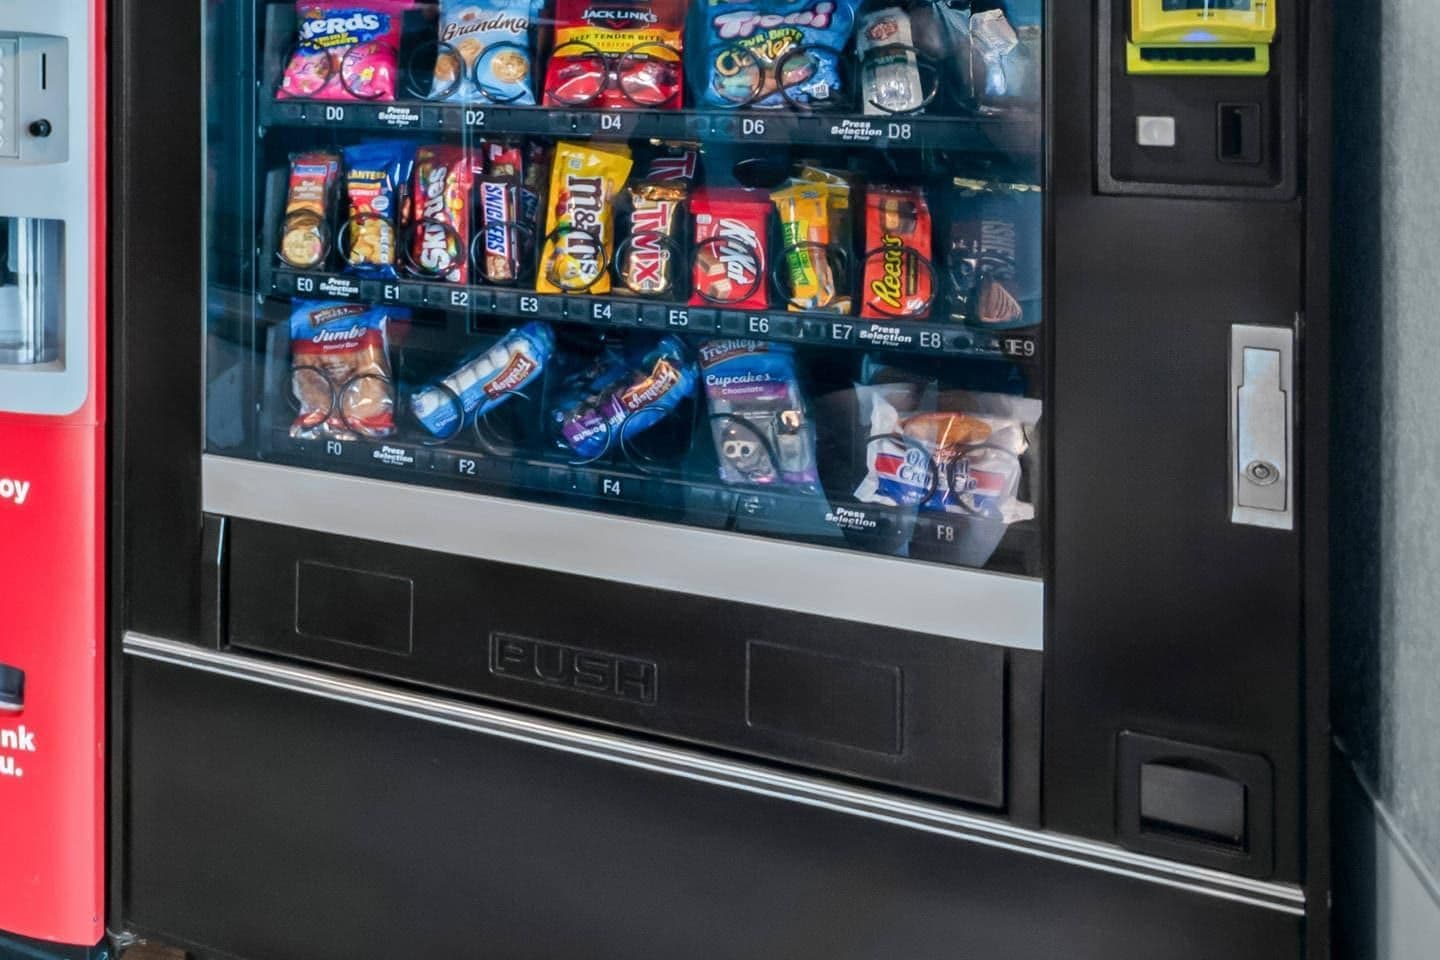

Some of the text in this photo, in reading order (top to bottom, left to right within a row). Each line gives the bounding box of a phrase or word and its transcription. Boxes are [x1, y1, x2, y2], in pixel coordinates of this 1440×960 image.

[581, 10, 658, 23] JACK LINK'S
[594, 32, 635, 40] TENDER
[327, 107, 344, 120] D0
[466, 111, 484, 125] D2
[602, 115, 621, 129] D4
[743, 119, 764, 134] D6
[831, 126, 882, 137] Selection
[888, 124, 911, 139] D8
[483, 182, 507, 255] SNICKERS
[630, 201, 669, 283] TWIX
[297, 277, 313, 291] E0
[385, 286, 400, 299] E1
[452, 292, 469, 306] E2
[521, 298, 538, 312] E3
[594, 304, 612, 318] E4
[670, 310, 688, 326] E5
[750, 317, 769, 332] E6
[832, 324, 852, 339] E7
[859, 330, 912, 343] Selection
[920, 332, 941, 348] E8
[1012, 340, 1035, 356] E9
[706, 371, 771, 387] Cupcakes
[328, 442, 342, 455] F0
[459, 460, 475, 474] F2
[604, 480, 620, 494] F4
[825, 513, 877, 528] Selection
[936, 525, 954, 541] F8
[496, 636, 655, 701] PUSH
